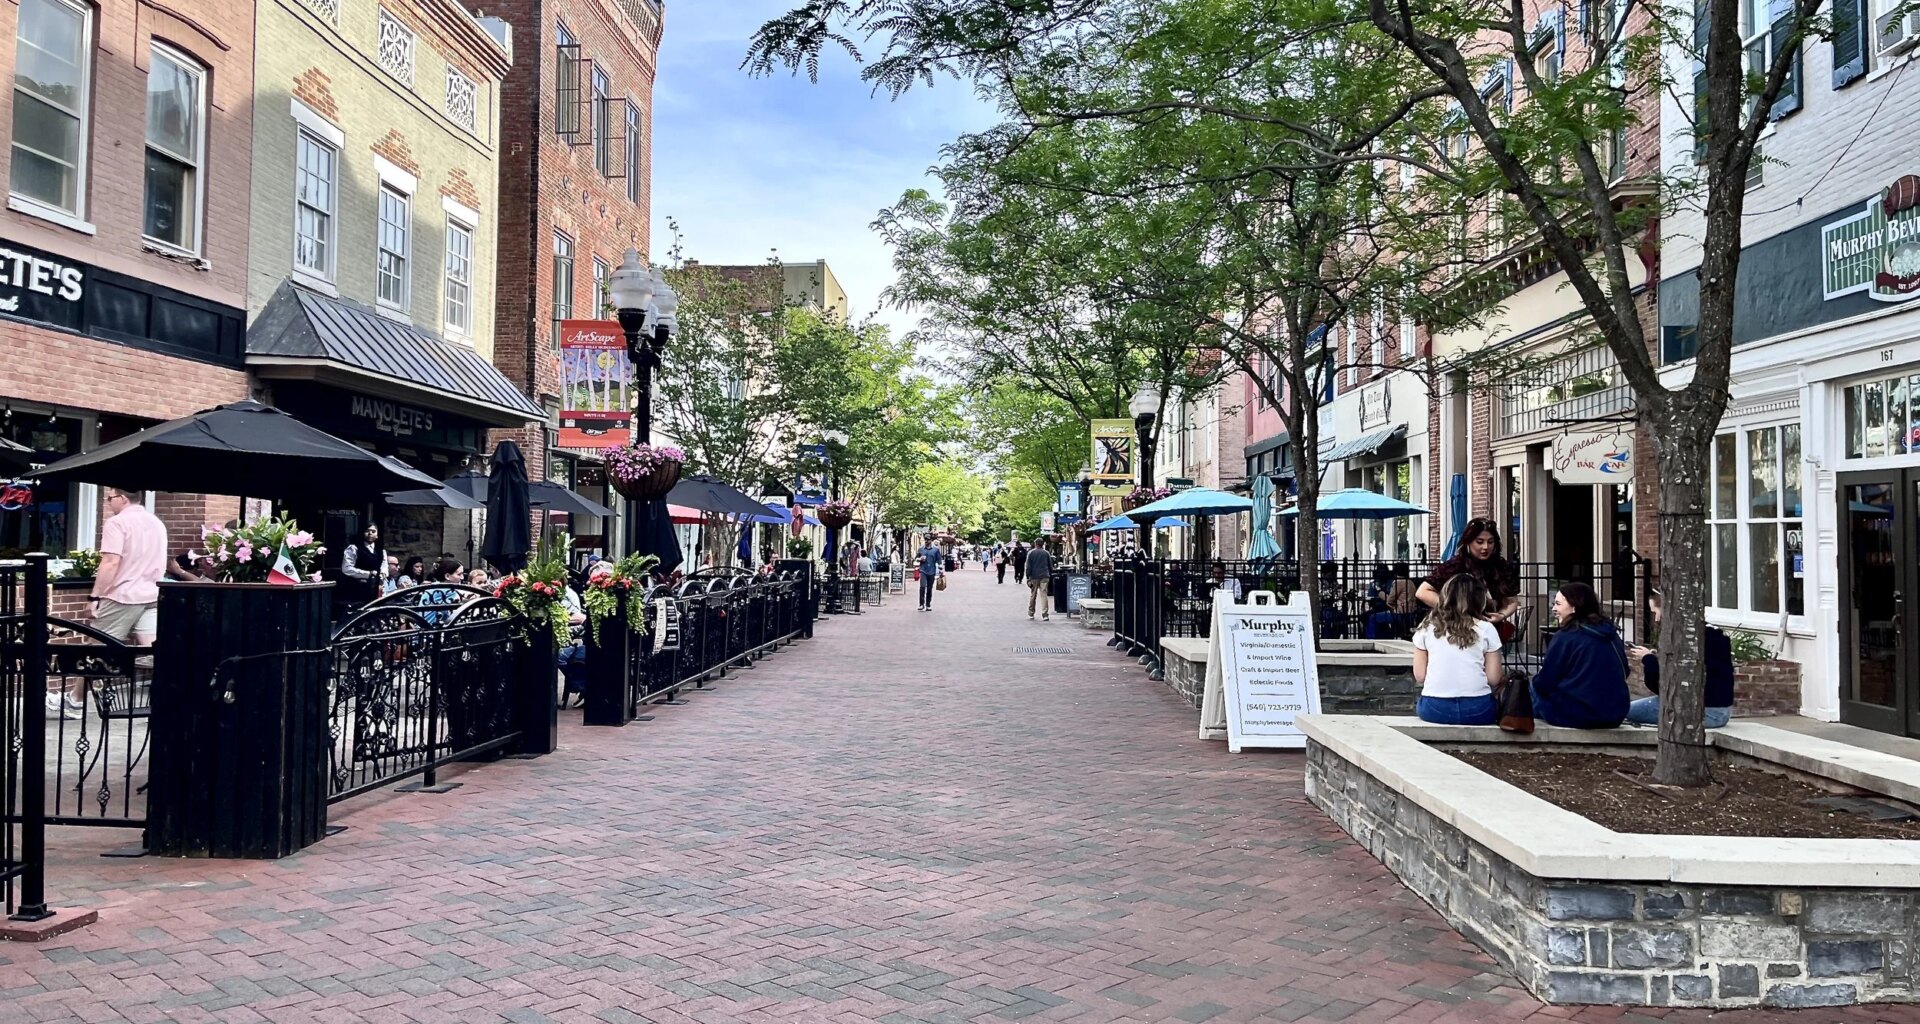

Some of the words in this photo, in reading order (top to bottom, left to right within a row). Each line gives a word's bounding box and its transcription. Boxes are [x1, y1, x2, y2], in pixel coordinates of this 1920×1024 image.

[1830, 229, 1884, 262] MURPHY
[567, 330, 616, 345] ArtScape
[1881, 349, 1893, 362] 167
[1555, 433, 1603, 474] Espresso
[1240, 619, 1294, 634] Murphy
[1246, 703, 1266, 712] (540)
